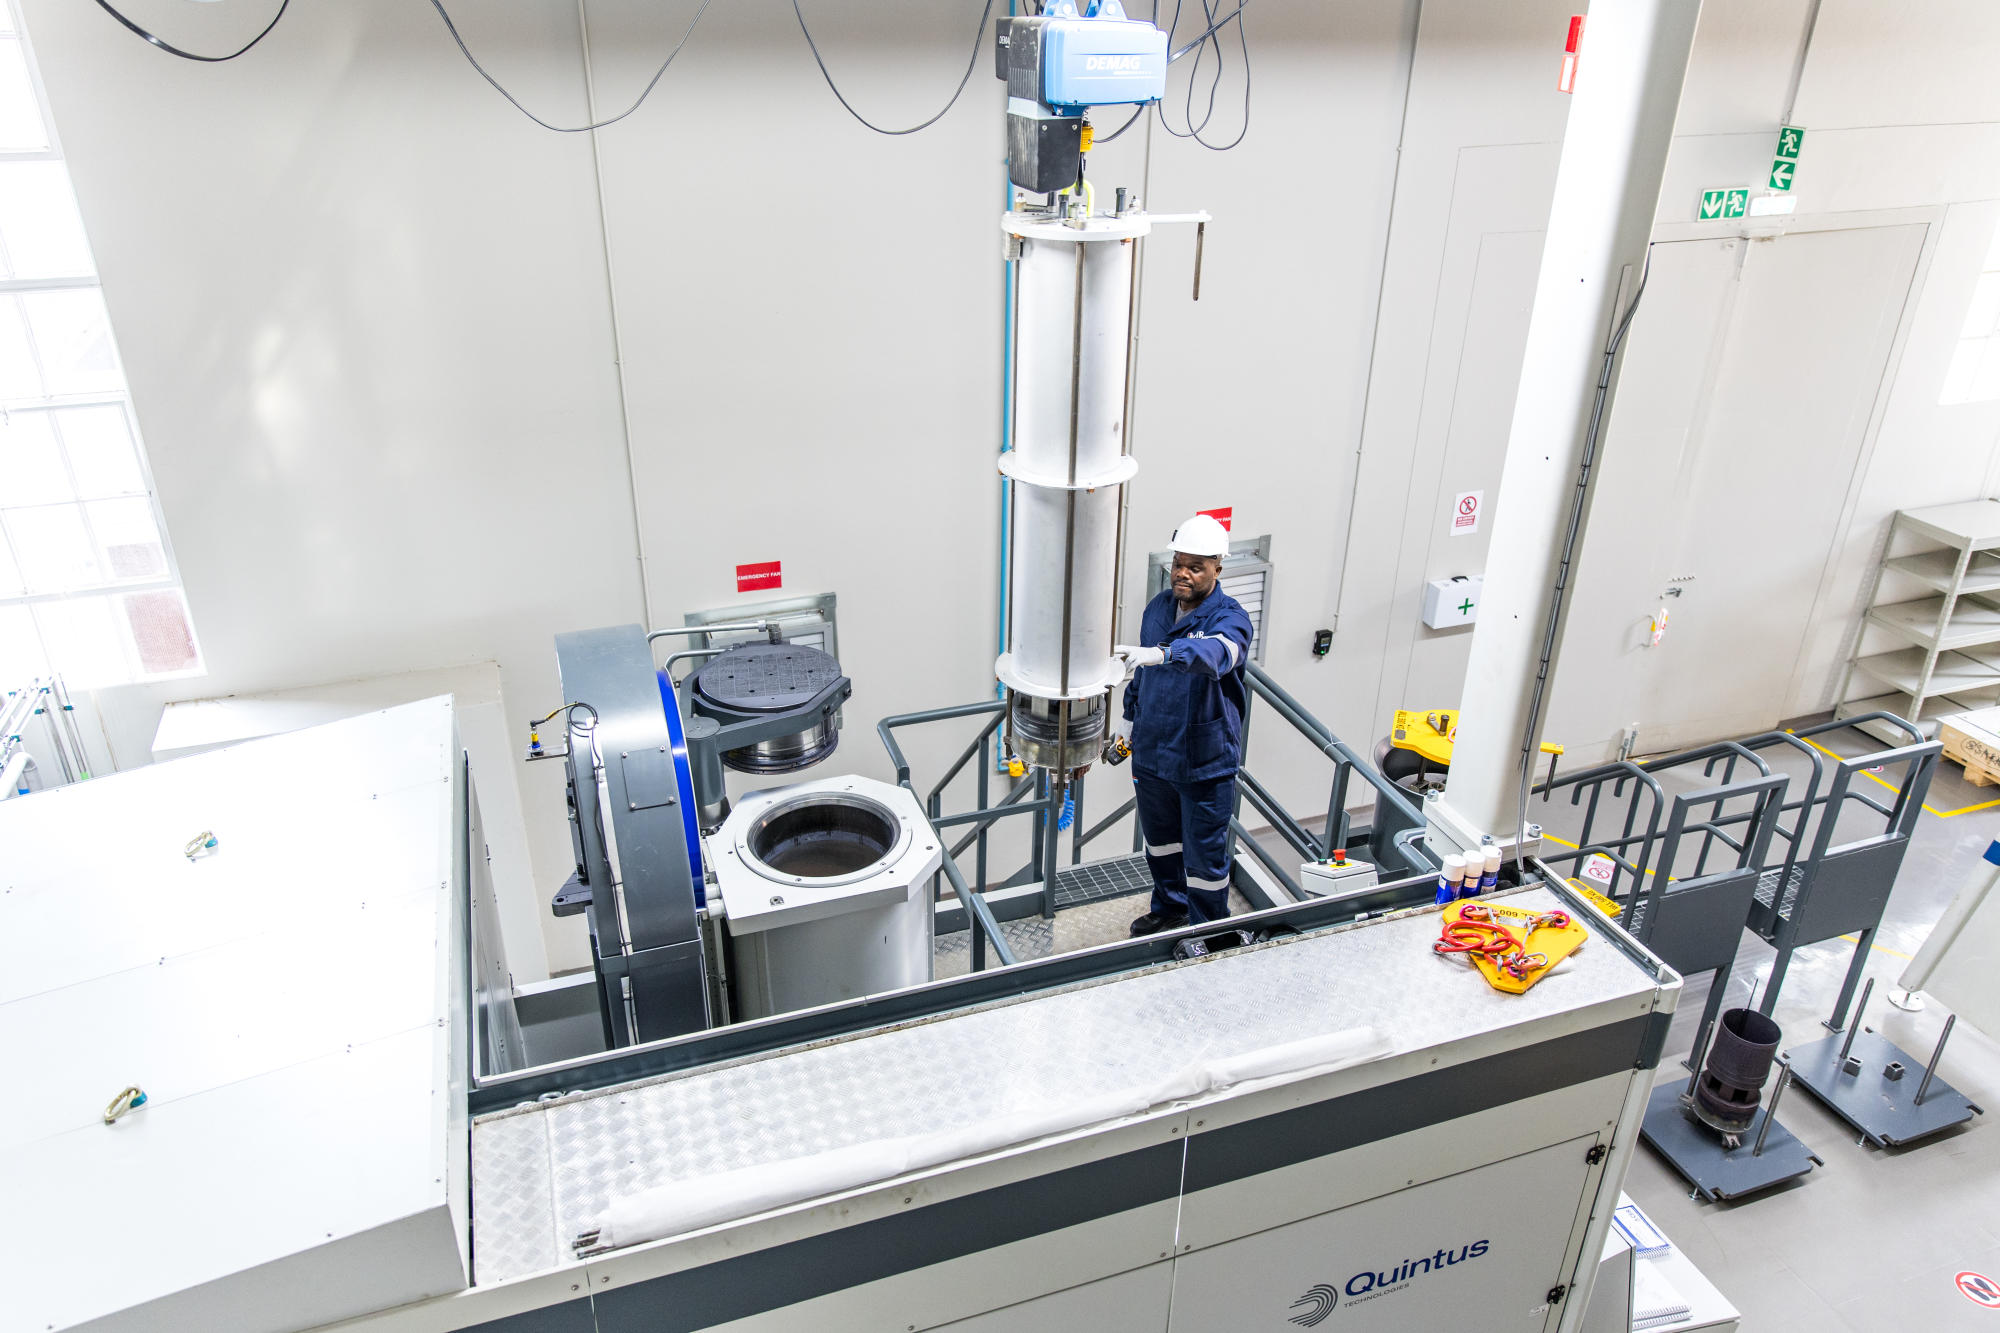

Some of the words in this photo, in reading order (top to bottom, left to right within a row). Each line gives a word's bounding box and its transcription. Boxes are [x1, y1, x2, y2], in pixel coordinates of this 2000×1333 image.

[999, 36, 1010, 45] DEMA
[1086, 56, 1141, 70] DEMAG
[737, 572, 770, 581] EMERGENCY
[1345, 1239, 1490, 1297] Quintus
[1343, 1282, 1410, 1308] TECHNOLOGIES
